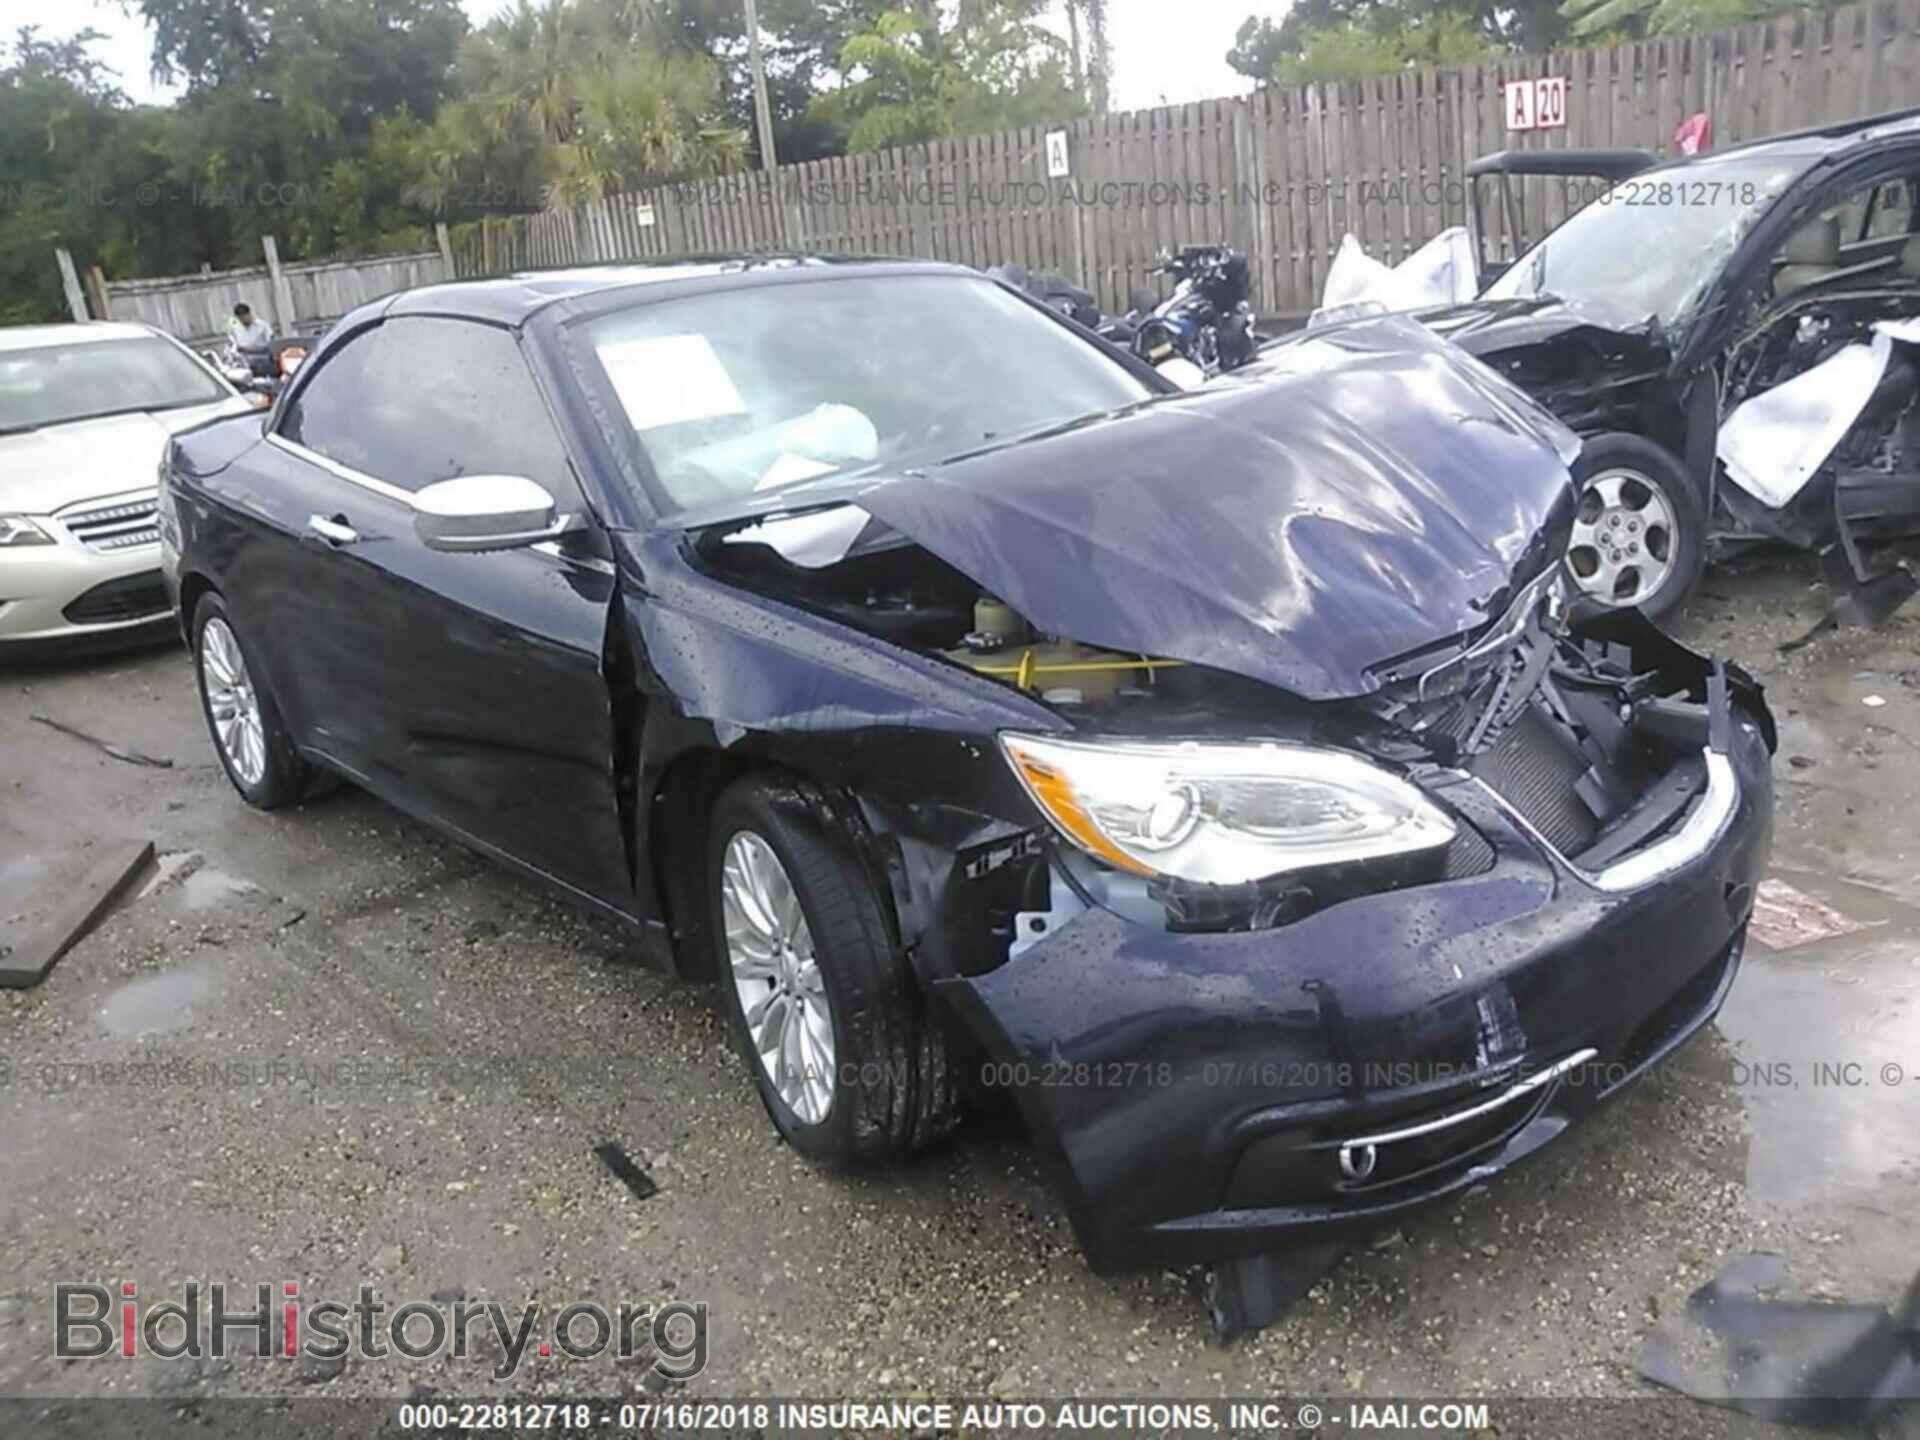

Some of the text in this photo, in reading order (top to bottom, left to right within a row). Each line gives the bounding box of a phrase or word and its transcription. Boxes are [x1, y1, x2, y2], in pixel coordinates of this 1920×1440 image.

[1514, 82, 1561, 125] A 20
[1052, 140, 1065, 169] A
